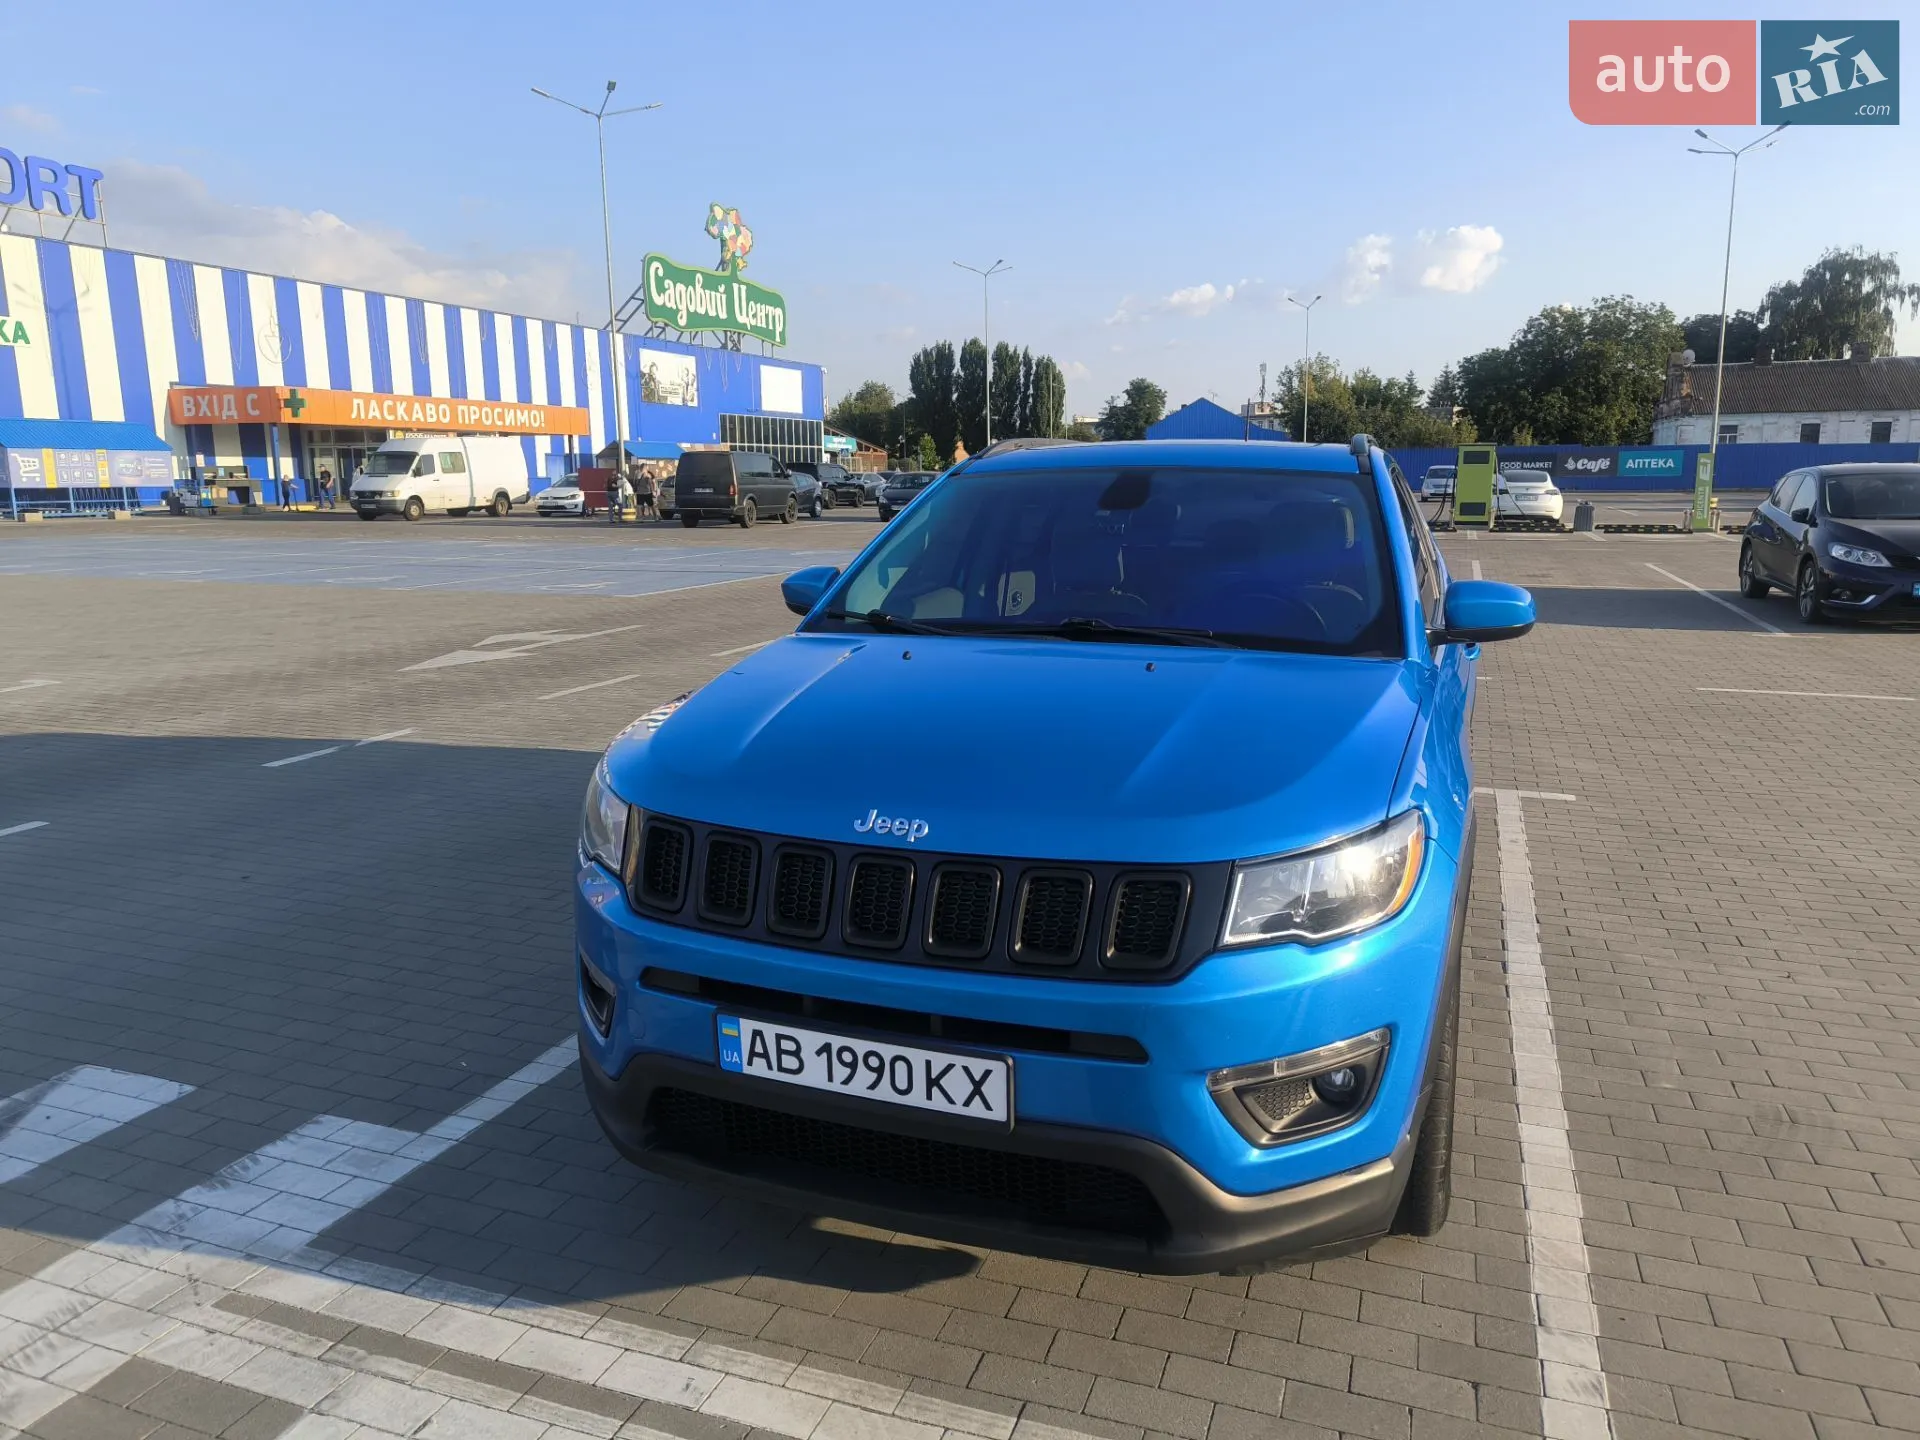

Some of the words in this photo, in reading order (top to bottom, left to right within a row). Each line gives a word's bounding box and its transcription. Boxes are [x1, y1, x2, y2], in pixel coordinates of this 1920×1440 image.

[649, 261, 728, 327] Садовий
[732, 282, 784, 342] Центр
[182, 394, 238, 420] ВХІД
[351, 398, 450, 423] ЛАСКАВО
[457, 404, 545, 428] ПРОСИМО!
[1500, 461, 1521, 469] FOOD
[1522, 461, 1553, 469] MARKET
[1576, 457, 1610, 473] Café
[1625, 458, 1675, 469] АПТЕКА
[853, 809, 929, 842] Jeep
[723, 1049, 741, 1064] UA
[746, 1028, 805, 1075] AB
[814, 1042, 913, 1096] 1990
[925, 1059, 994, 1112] KX
